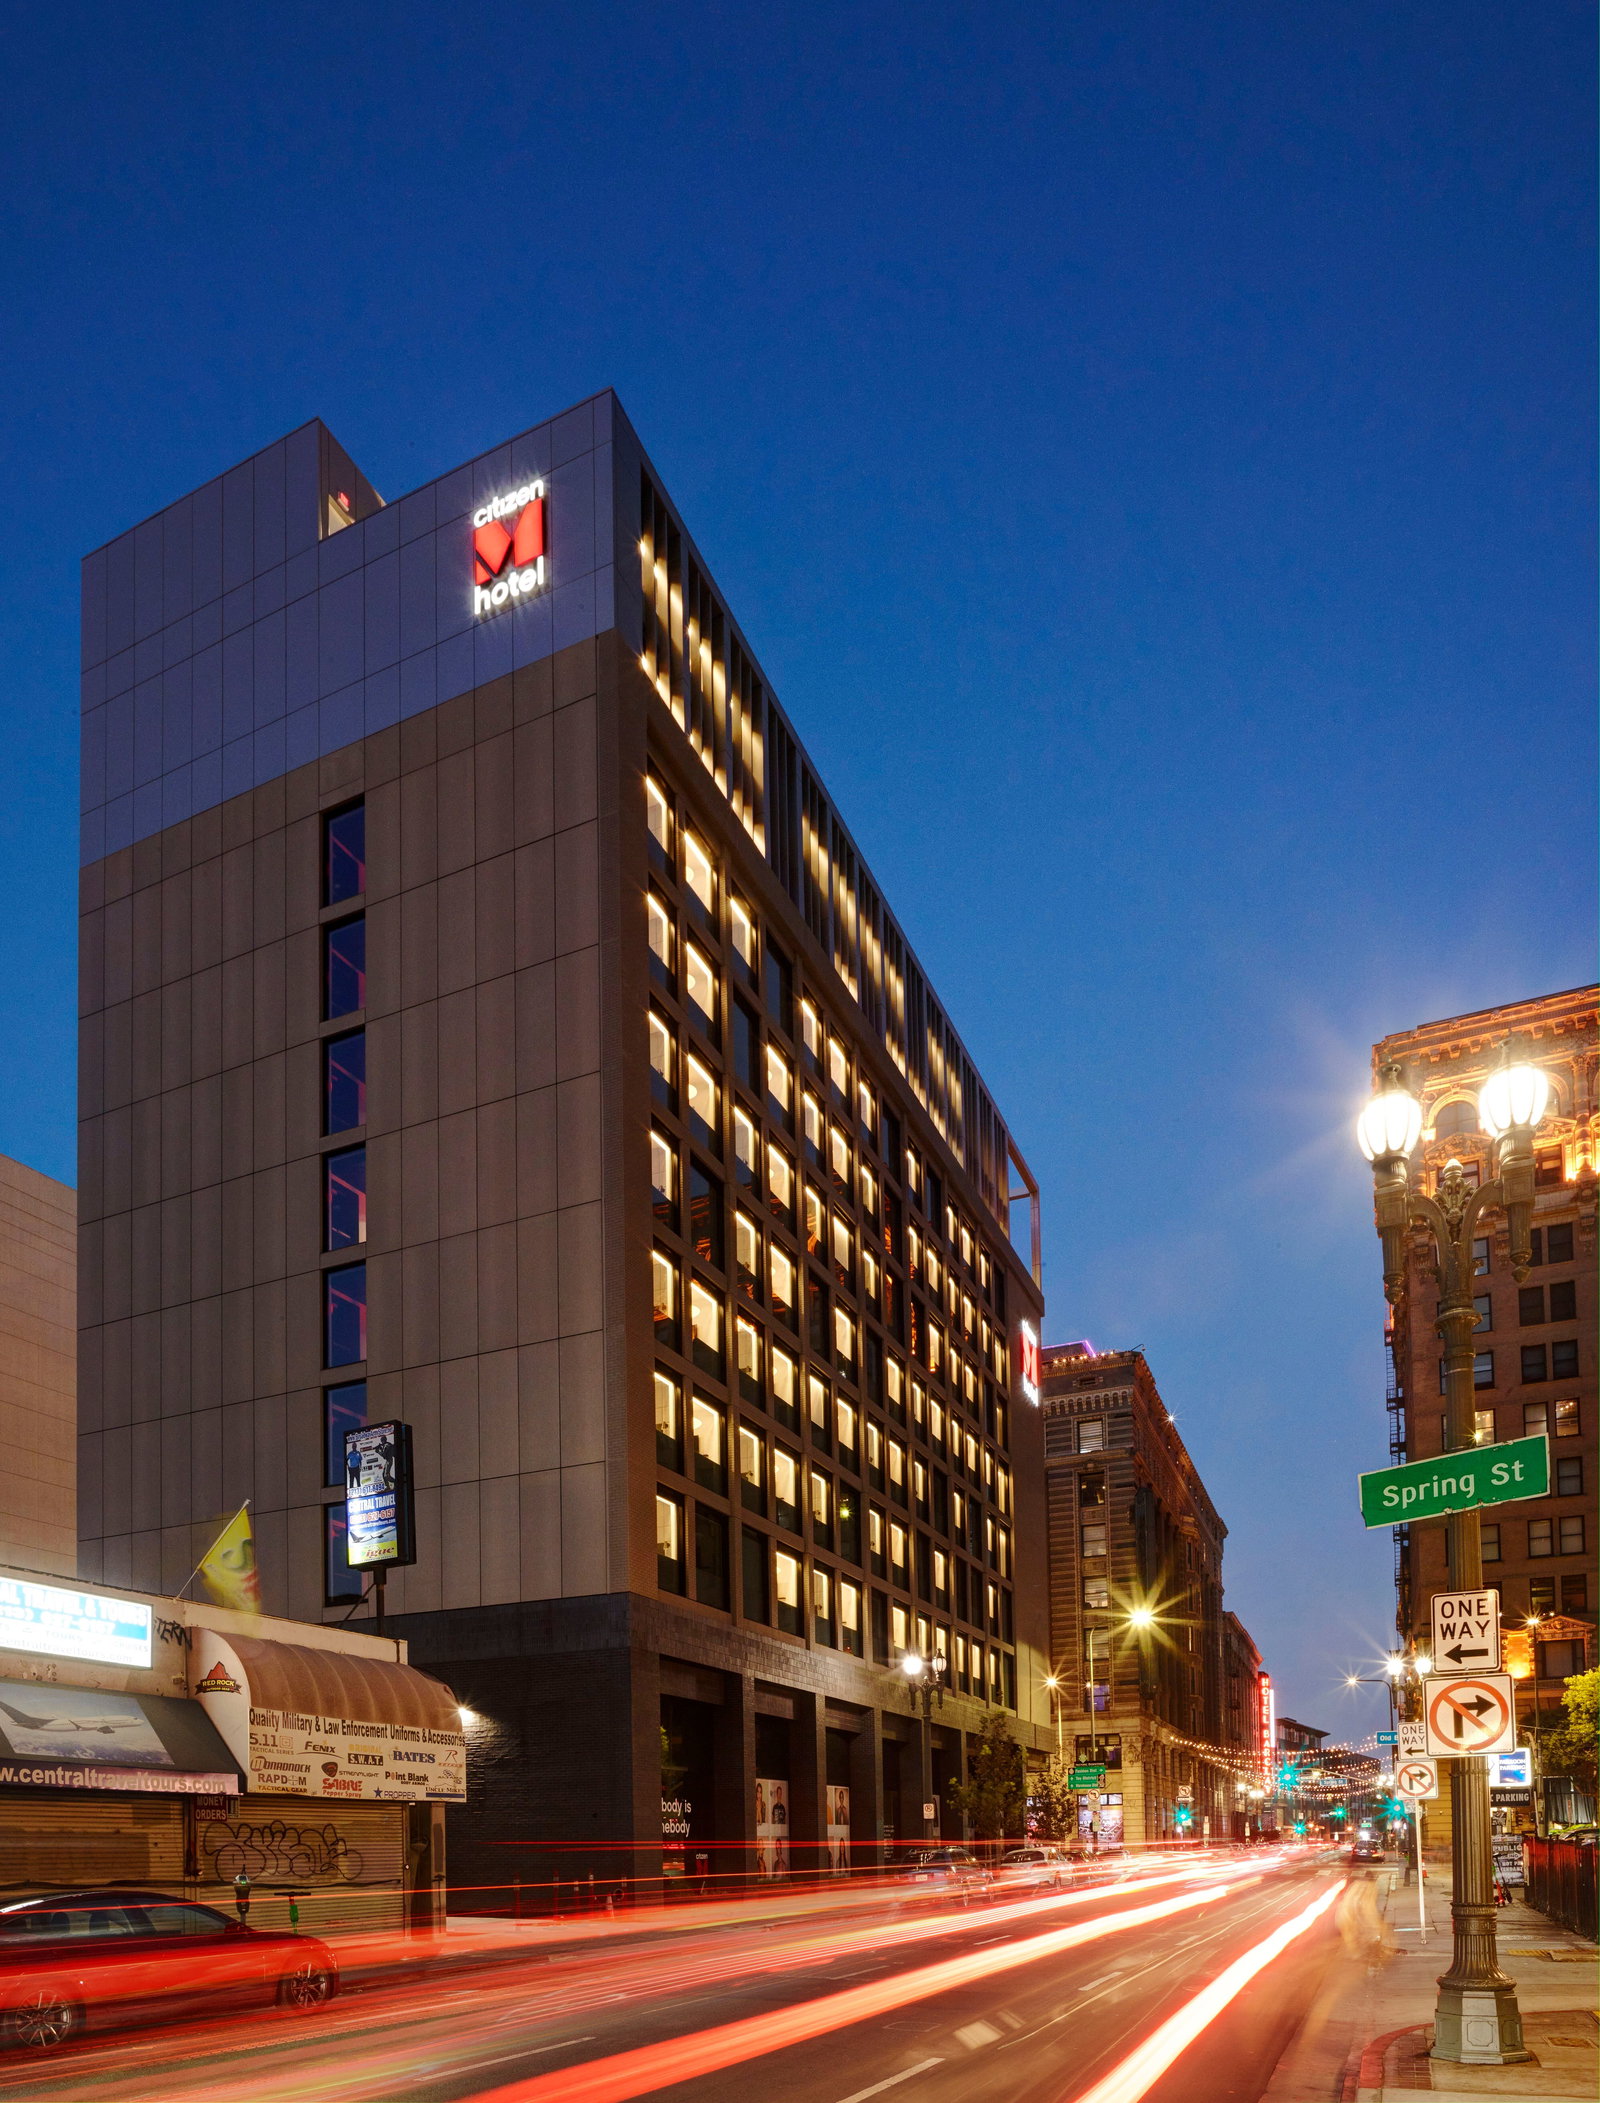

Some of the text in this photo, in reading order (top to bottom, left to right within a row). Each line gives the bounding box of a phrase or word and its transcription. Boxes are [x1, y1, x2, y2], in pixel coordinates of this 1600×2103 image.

[473, 479, 544, 527] citizen
[473, 555, 544, 615] hotel
[1382, 1460, 1525, 1509] Spring St
[375, 1494, 395, 1509] TRAVEL
[1441, 1599, 1490, 1619] ONE
[1440, 1620, 1491, 1640] WAY
[217, 1679, 235, 1687] ROCK
[1261, 1678, 1270, 1724] HOTEL
[249, 1707, 466, 1747] Quality Military & Law Enforcement Uniforms & Accessories
[1402, 1725, 1425, 1735] ONE
[249, 1732, 278, 1747] 5.11
[1401, 1735, 1425, 1745] WAY
[349, 1754, 383, 1766] S.W.A.T.
[393, 1750, 436, 1763] BATES
[385, 1771, 429, 1782] Point Blank
[322, 1778, 363, 1791] SABRE
[323, 1789, 362, 1798] Pepper Spray
[384, 1790, 417, 1800] PROPPER
[1495, 1793, 1530, 1802] PARKING
[196, 1796, 224, 1807] MONEY
[684, 1800, 692, 1813] is
[196, 1809, 226, 1820] ORDERS
[1492, 1844, 1523, 1852] PUBLIC
